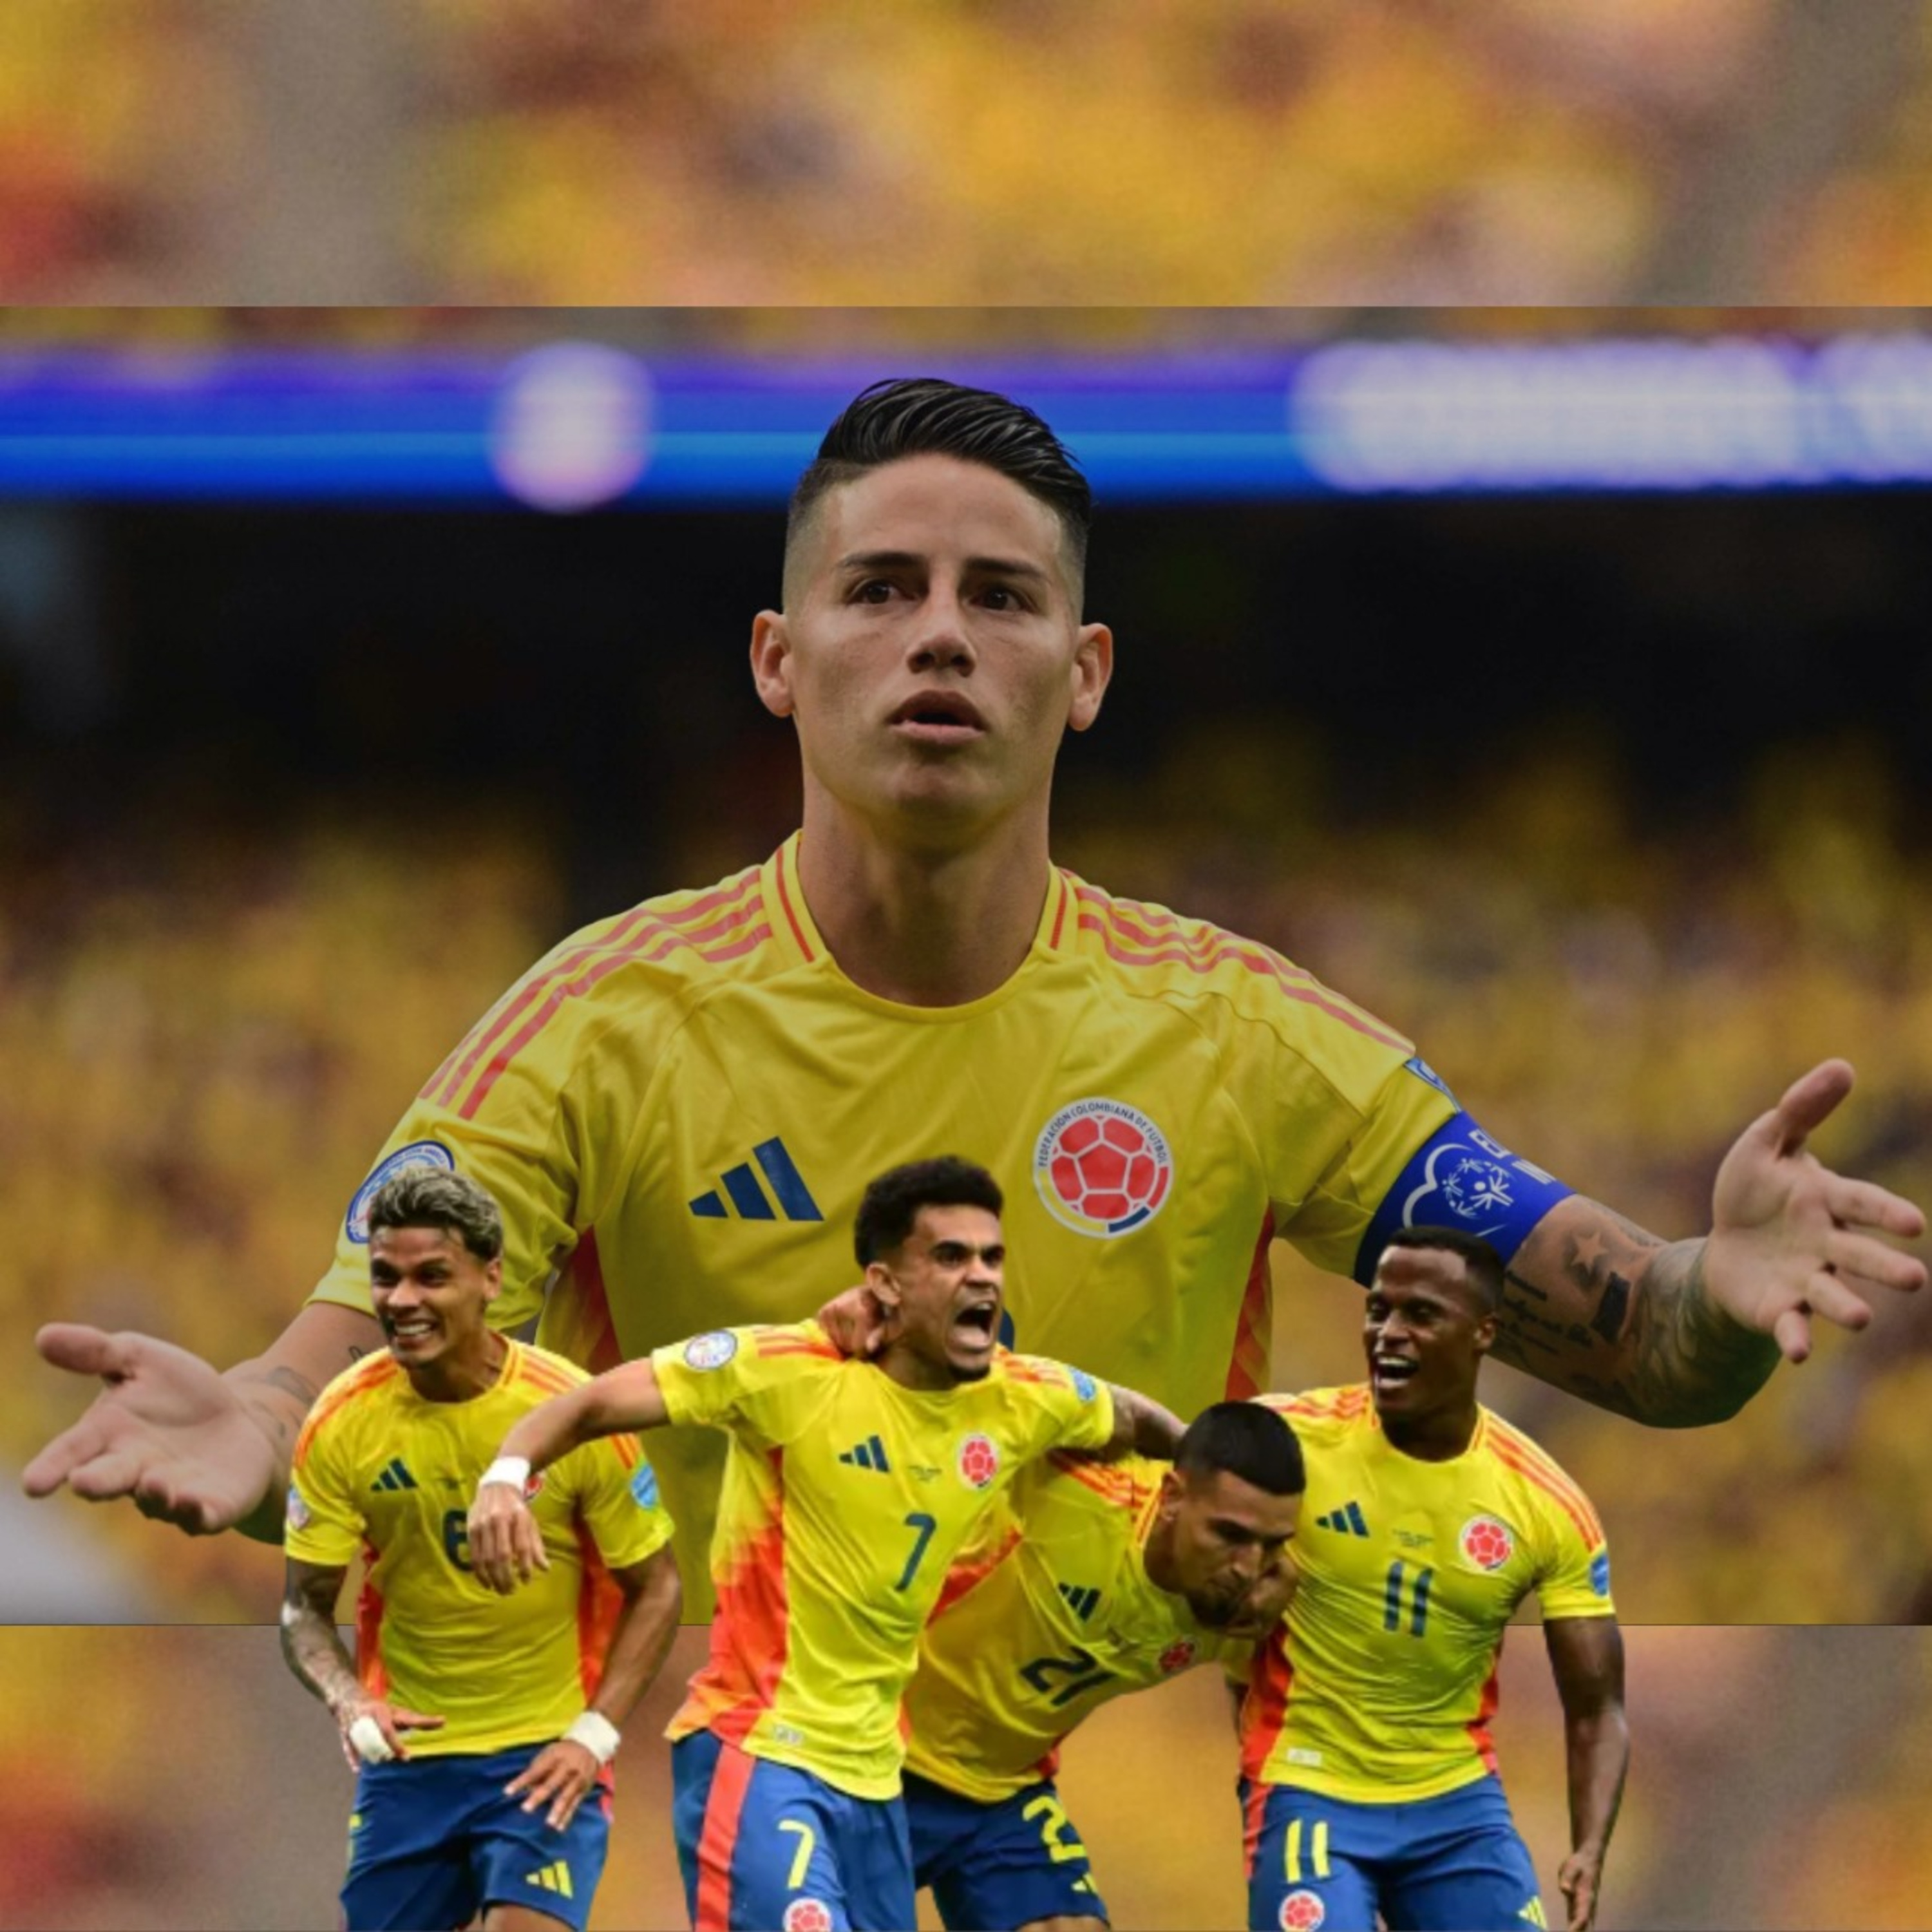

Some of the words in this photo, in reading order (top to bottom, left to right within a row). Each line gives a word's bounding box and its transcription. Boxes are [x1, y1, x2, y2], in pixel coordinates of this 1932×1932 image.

[1070, 1103, 1135, 1121] COLOMBIANA
[1135, 1117, 1148, 1130] DE
[895, 1513, 936, 1592] 7
[1385, 1560, 1434, 1638] 11
[779, 1819, 814, 1889] 7
[1285, 1819, 1331, 1884] 11
